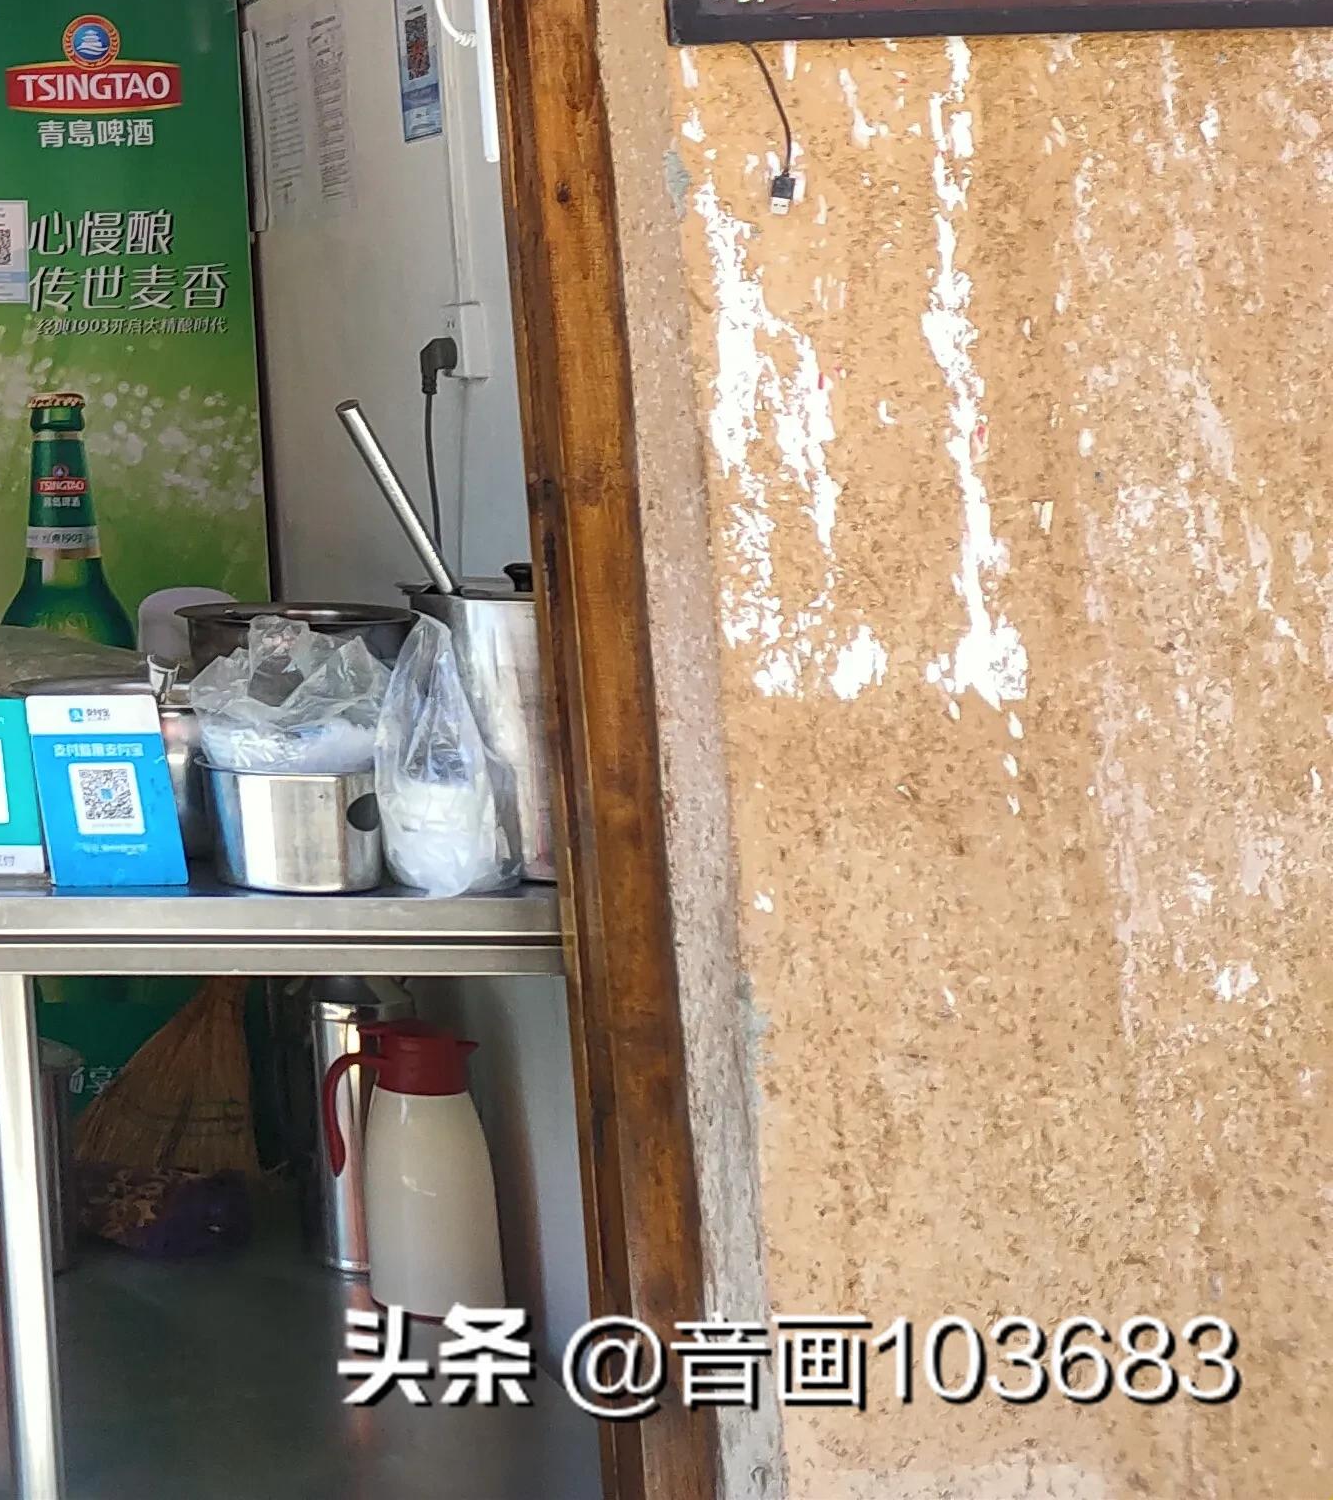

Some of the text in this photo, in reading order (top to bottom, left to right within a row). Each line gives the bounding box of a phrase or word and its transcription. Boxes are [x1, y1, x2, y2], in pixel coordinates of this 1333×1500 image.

[16, 70, 172, 102] TSINGTAO
[36, 117, 155, 149] 青岛啤酒
[28, 262, 233, 313] 传世麦香
